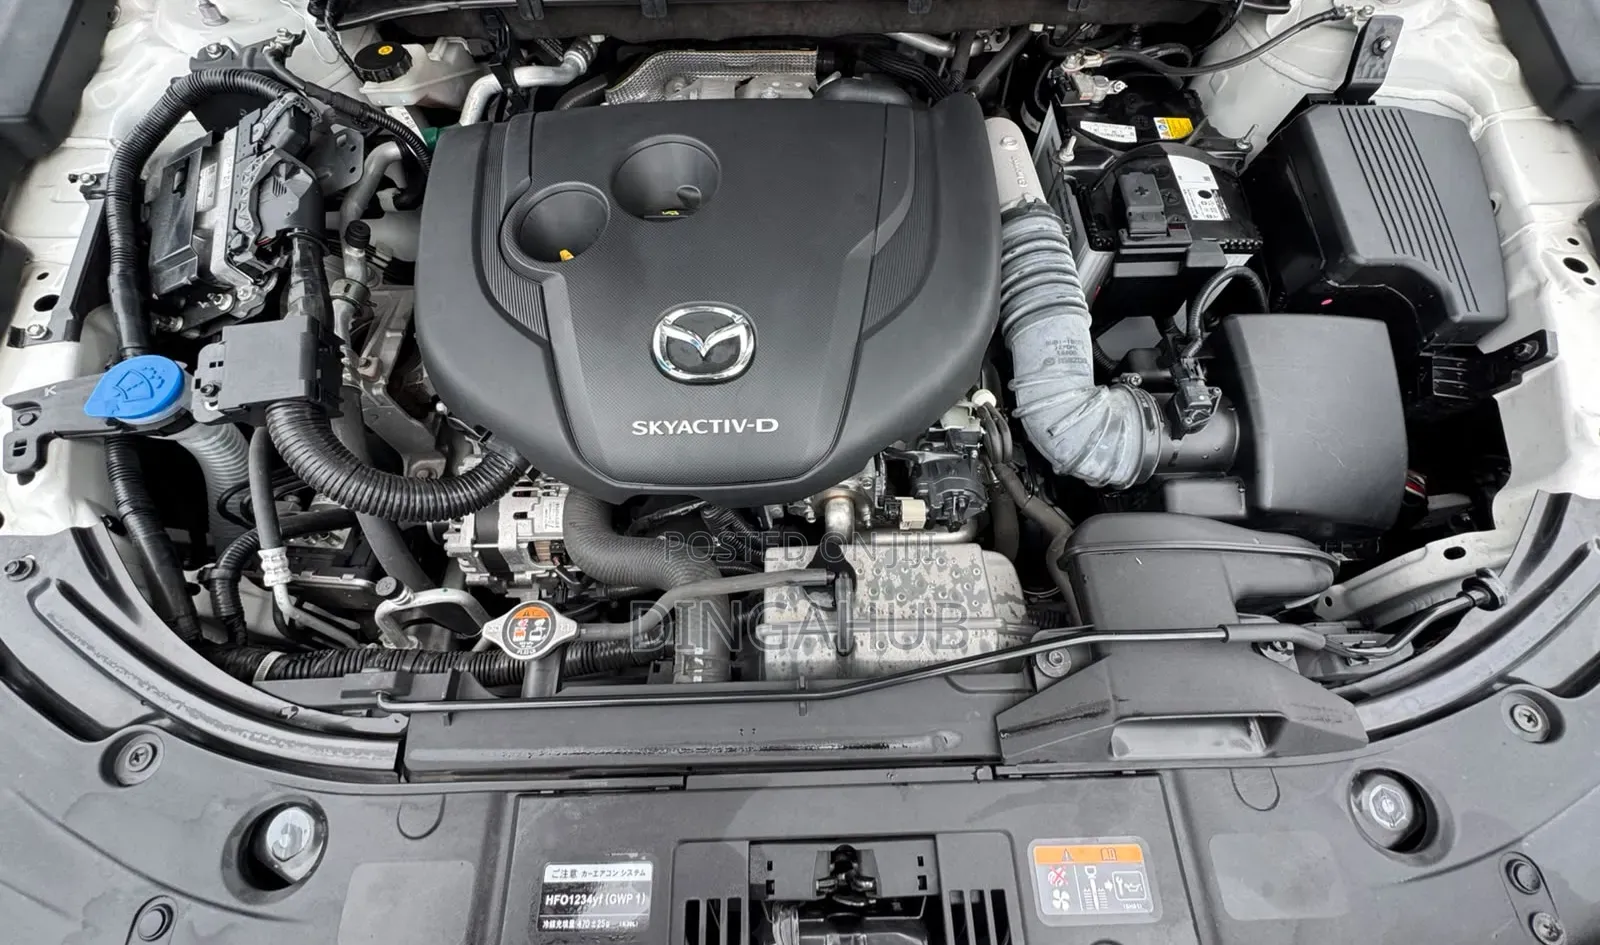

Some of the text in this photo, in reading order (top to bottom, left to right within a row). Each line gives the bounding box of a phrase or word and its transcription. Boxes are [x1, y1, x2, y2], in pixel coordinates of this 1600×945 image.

[631, 418, 780, 436] SKYACTIV-D
[551, 868, 646, 879] ご注意 カーエアコン システム
[545, 893, 603, 908] HFO1234yf
[605, 893, 634, 906] (GWP
